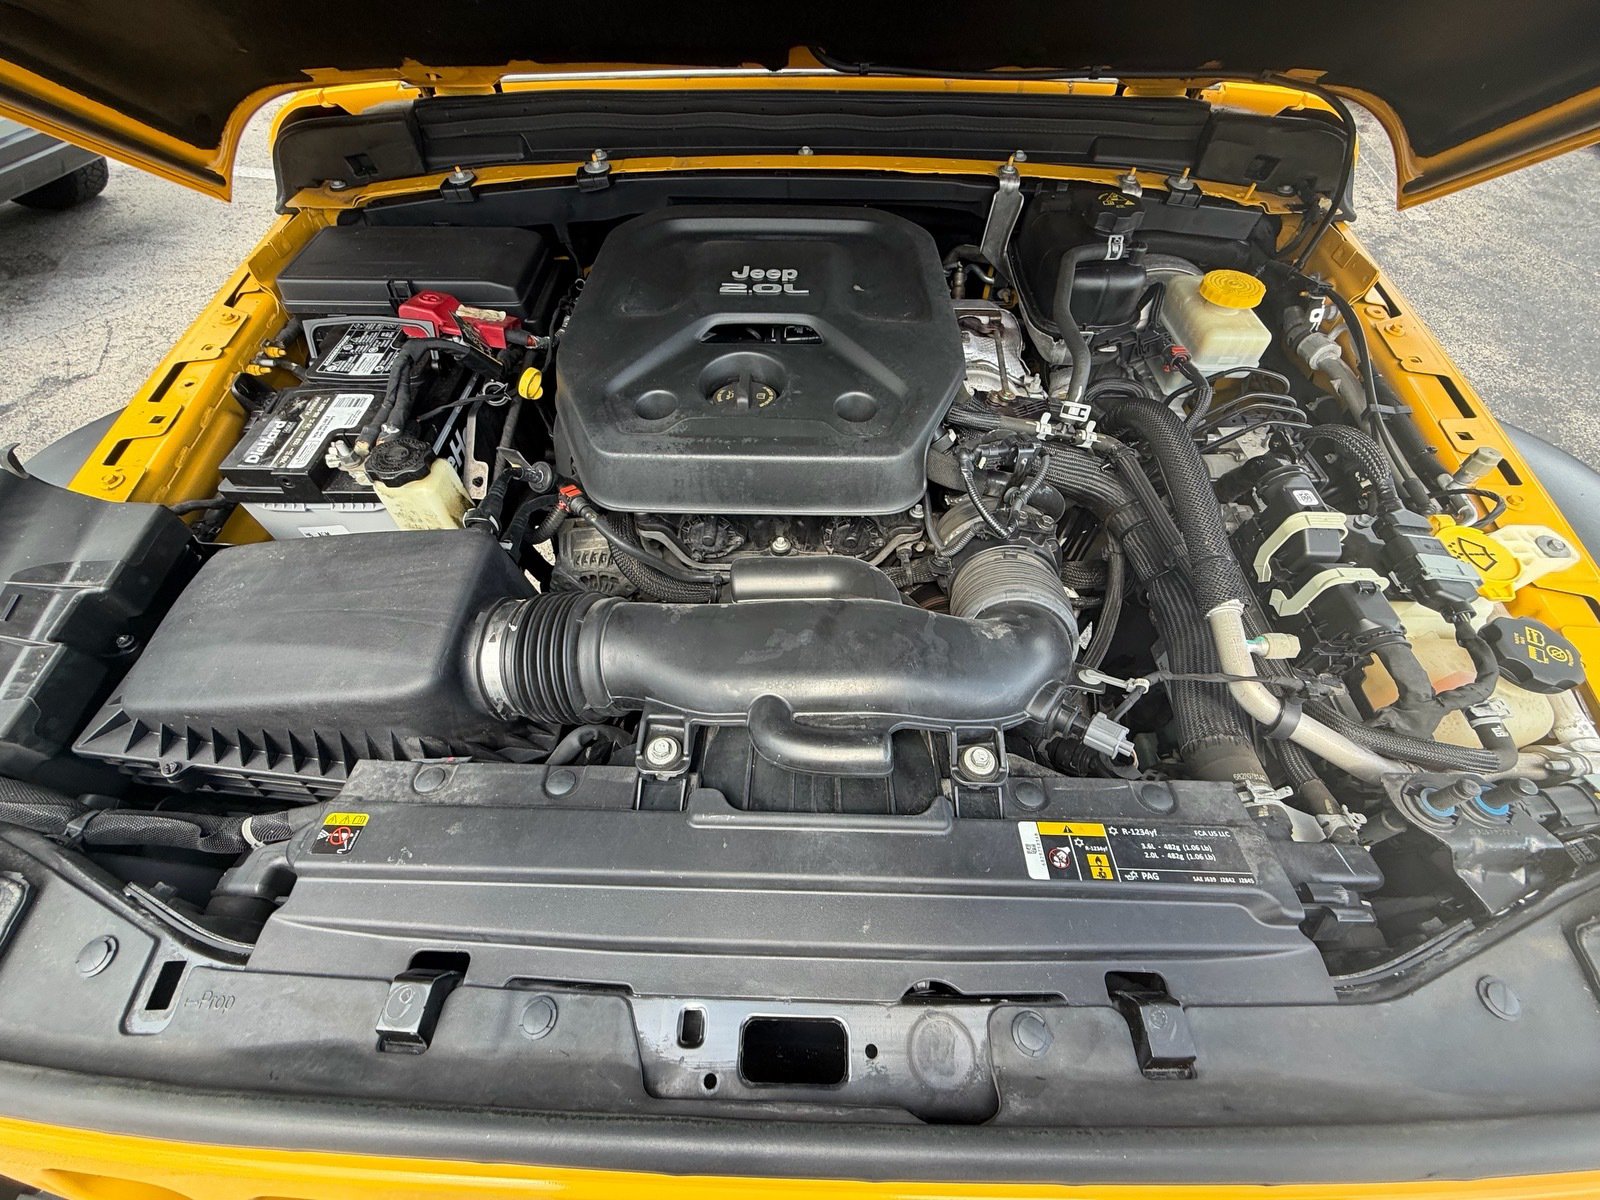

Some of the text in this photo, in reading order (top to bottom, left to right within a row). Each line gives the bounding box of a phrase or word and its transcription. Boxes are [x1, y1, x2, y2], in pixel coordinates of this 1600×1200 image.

[731, 265, 798, 283] Jeep
[719, 283, 809, 296] 2.0L
[244, 420, 286, 463] DieHard
[1122, 828, 1157, 838] R-1234yf
[1167, 852, 1184, 860] 482g
[1204, 854, 1216, 862] Lb)
[1141, 872, 1160, 880] PAG
[198, 990, 236, 1014] Prop
